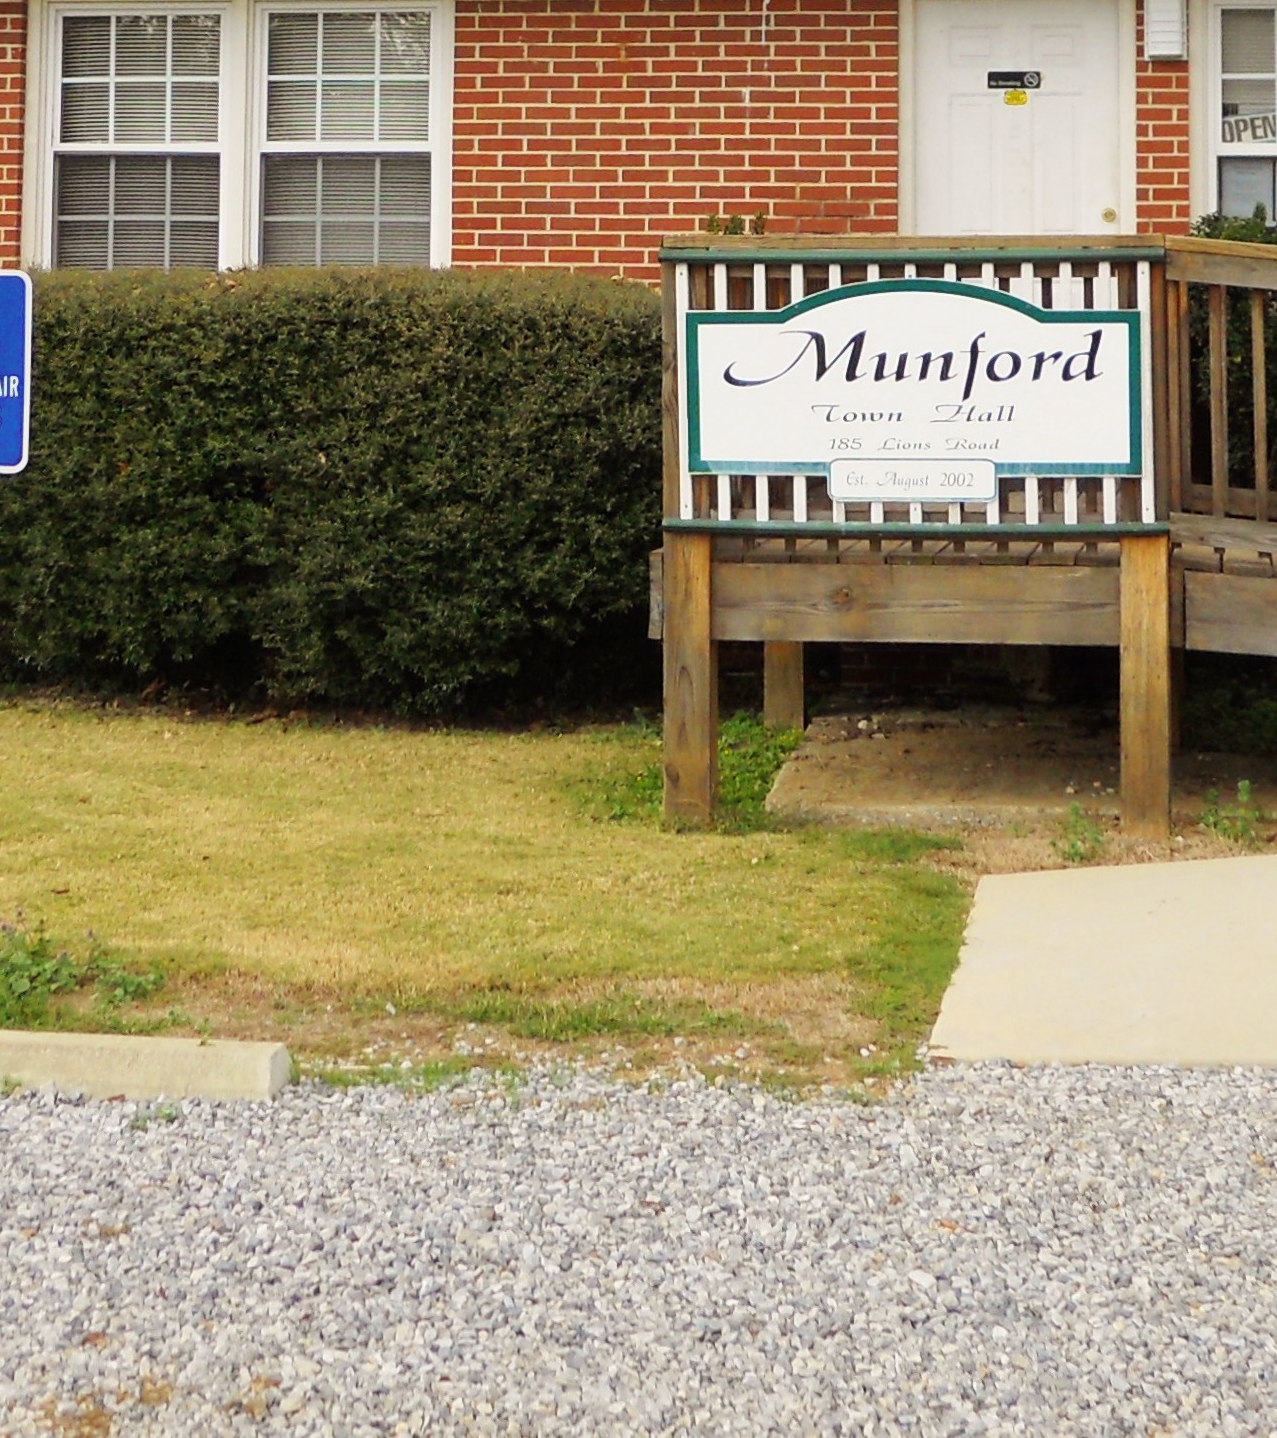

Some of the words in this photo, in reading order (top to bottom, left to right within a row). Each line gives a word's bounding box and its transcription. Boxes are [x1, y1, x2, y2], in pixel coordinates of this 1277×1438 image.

[1222, 114, 1276, 143] OPEN
[723, 329, 1104, 402] Munford
[811, 404, 903, 423] Town
[930, 404, 1014, 423] Hall
[829, 437, 862, 451] 185
[877, 437, 931, 451] Lions
[945, 437, 1001, 451] Road
[845, 471, 868, 487] Est.
[876, 470, 929, 491] August
[939, 472, 974, 487] 2002
